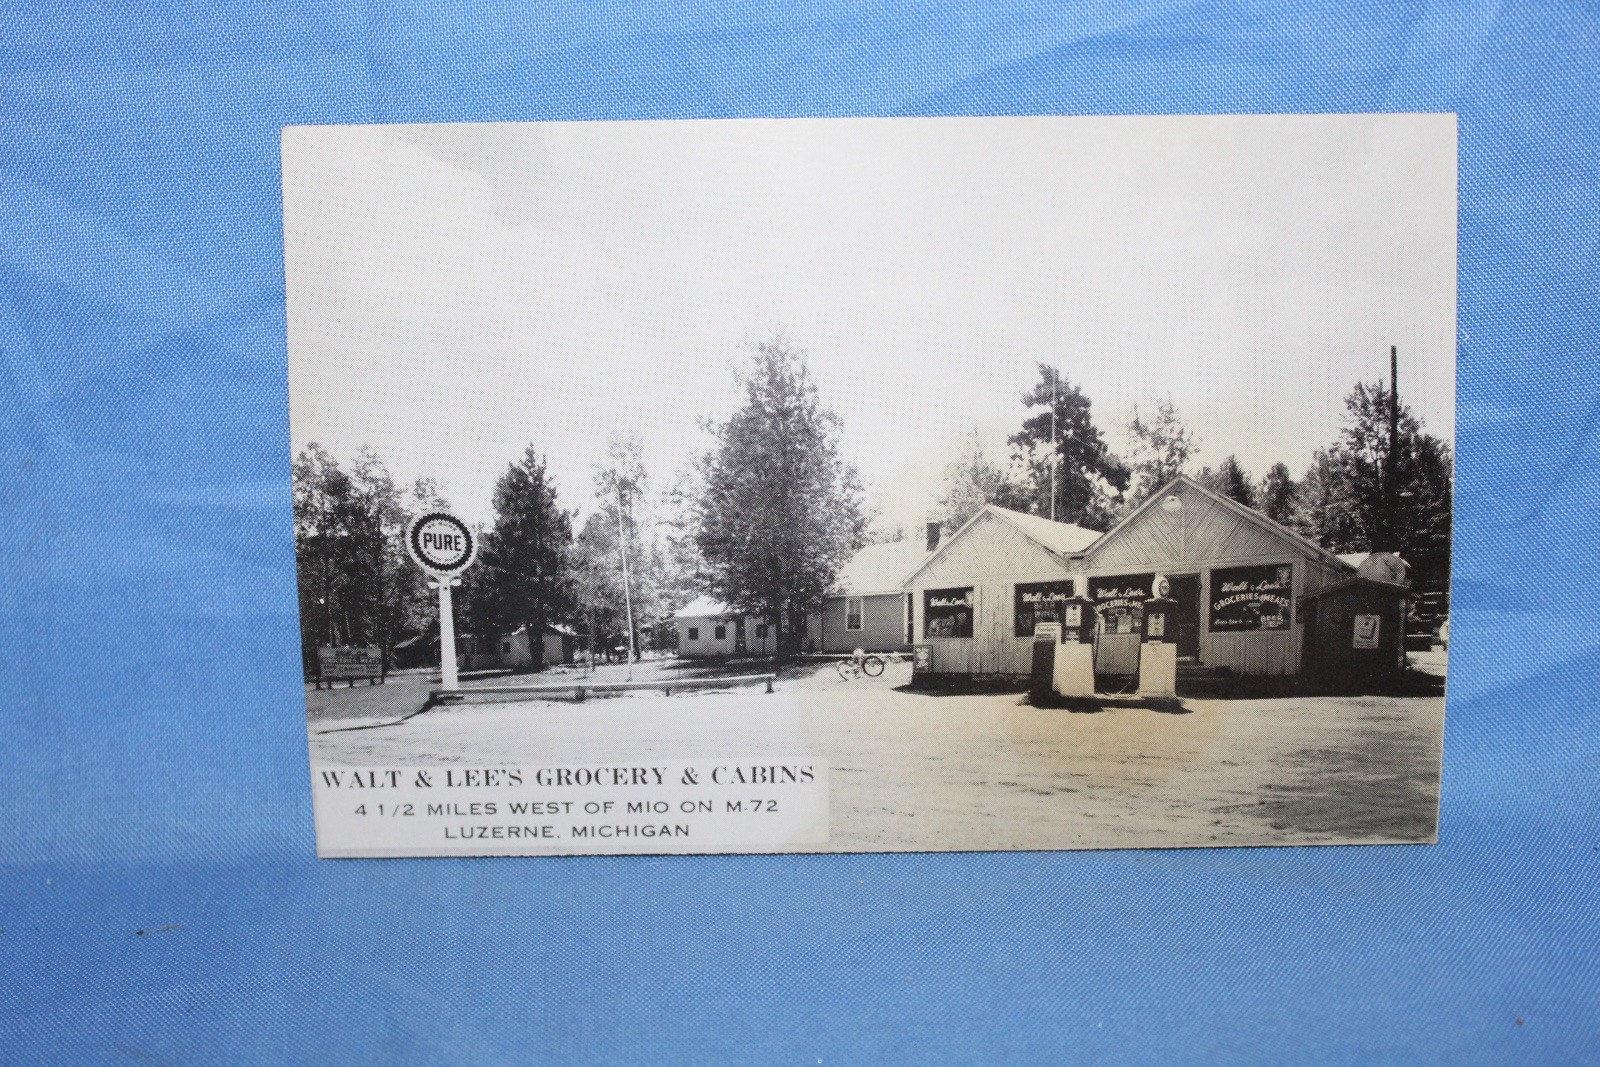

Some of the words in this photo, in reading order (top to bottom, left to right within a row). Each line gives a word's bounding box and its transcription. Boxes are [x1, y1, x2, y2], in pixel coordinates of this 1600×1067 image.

[423, 532, 461, 552] PURE
[1213, 592, 1259, 611] GROCERIES
[1263, 594, 1290, 607] MEATS
[322, 770, 402, 788] WALT
[414, 770, 433, 787] &
[445, 769, 523, 787] LEE'S
[536, 767, 669, 787] GROCERY
[681, 767, 700, 785] &
[712, 765, 815, 784] CABINS
[355, 803, 368, 817] 4
[427, 802, 498, 816] MILES
[509, 801, 574, 815] WEST
[584, 801, 615, 815] OF
[627, 800, 670, 814] MIO
[680, 799, 713, 814] ON
[726, 799, 780, 813] M-72
[572, 824, 690, 839] MICHIGAN
